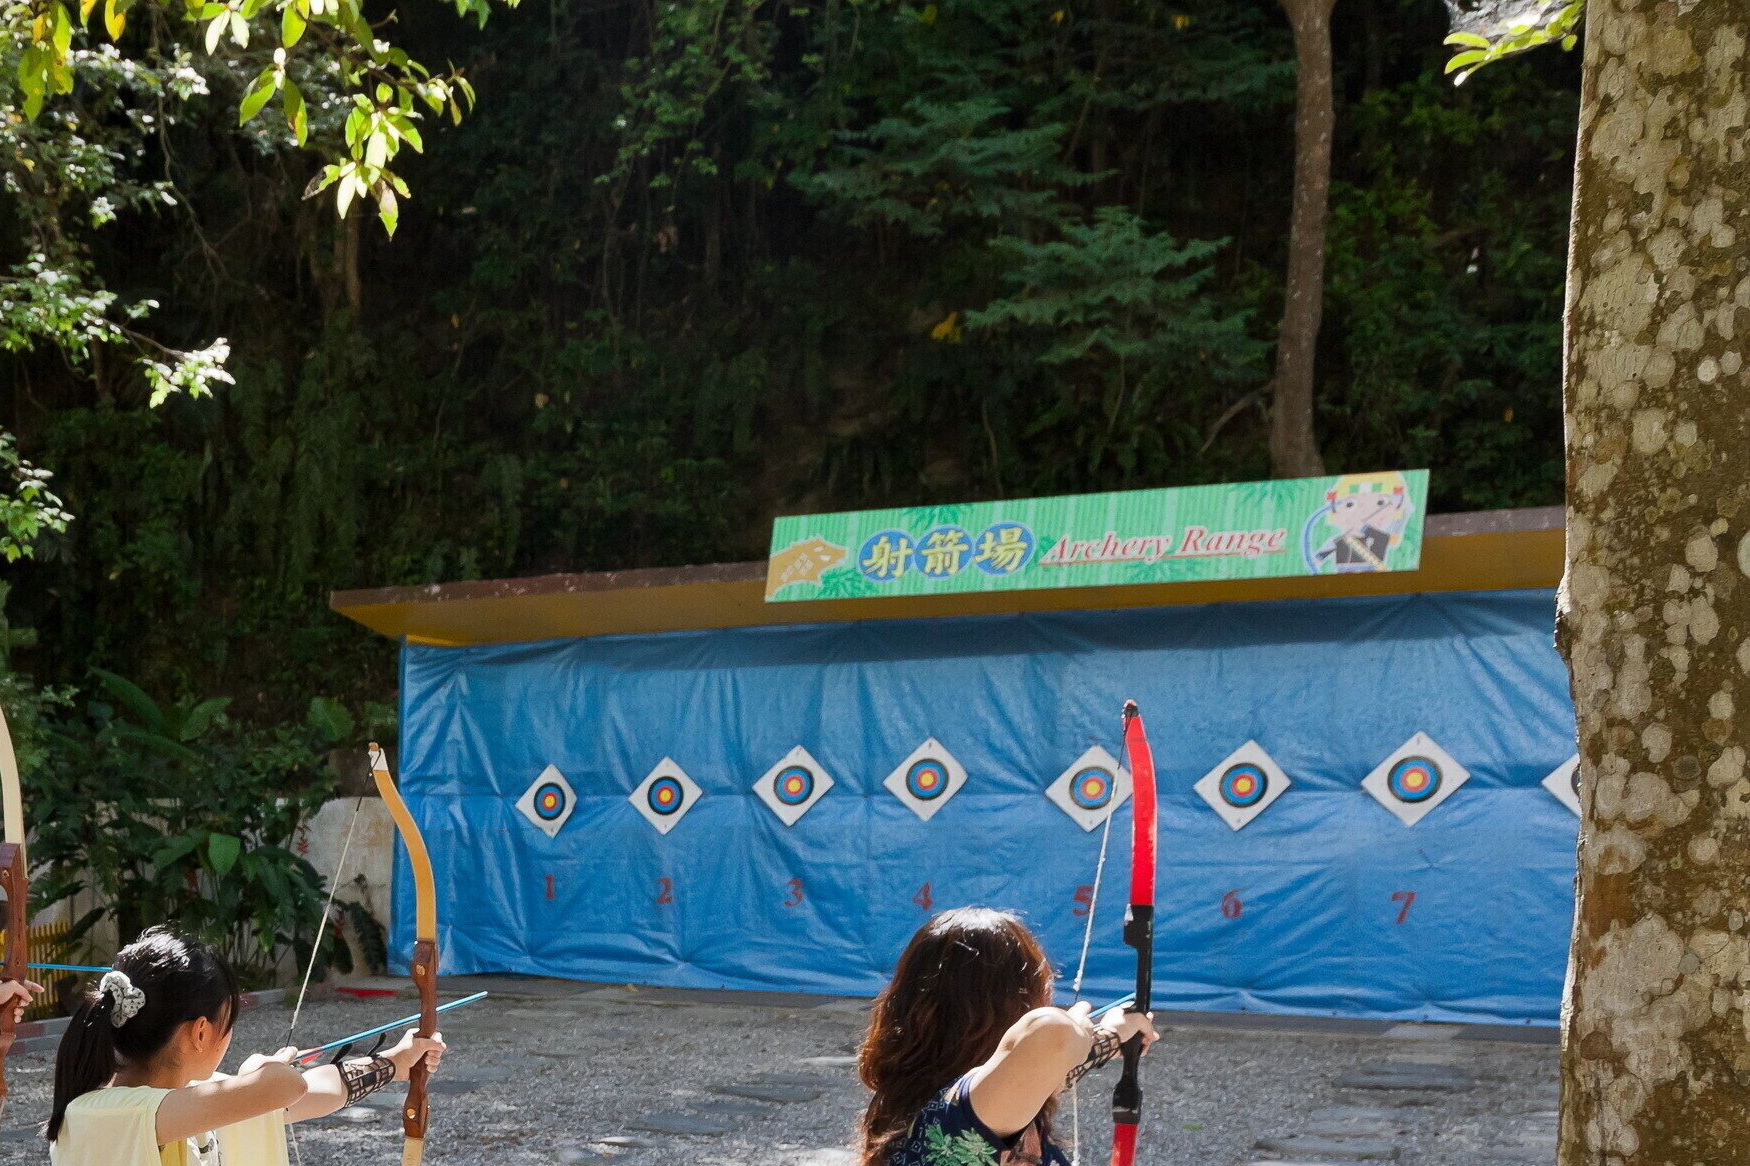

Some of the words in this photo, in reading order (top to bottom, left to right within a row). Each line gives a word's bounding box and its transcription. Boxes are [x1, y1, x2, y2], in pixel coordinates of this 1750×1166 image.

[863, 527, 1031, 578] 射箭場
[1047, 532, 1169, 561] Archery
[1179, 528, 1286, 556] Range
[544, 874, 554, 900] 1
[656, 877, 673, 904] 2
[784, 879, 803, 907] 3
[912, 882, 933, 911] 4
[1073, 885, 1095, 917] 5
[1221, 889, 1243, 919] 6
[1390, 892, 1417, 925] 7
